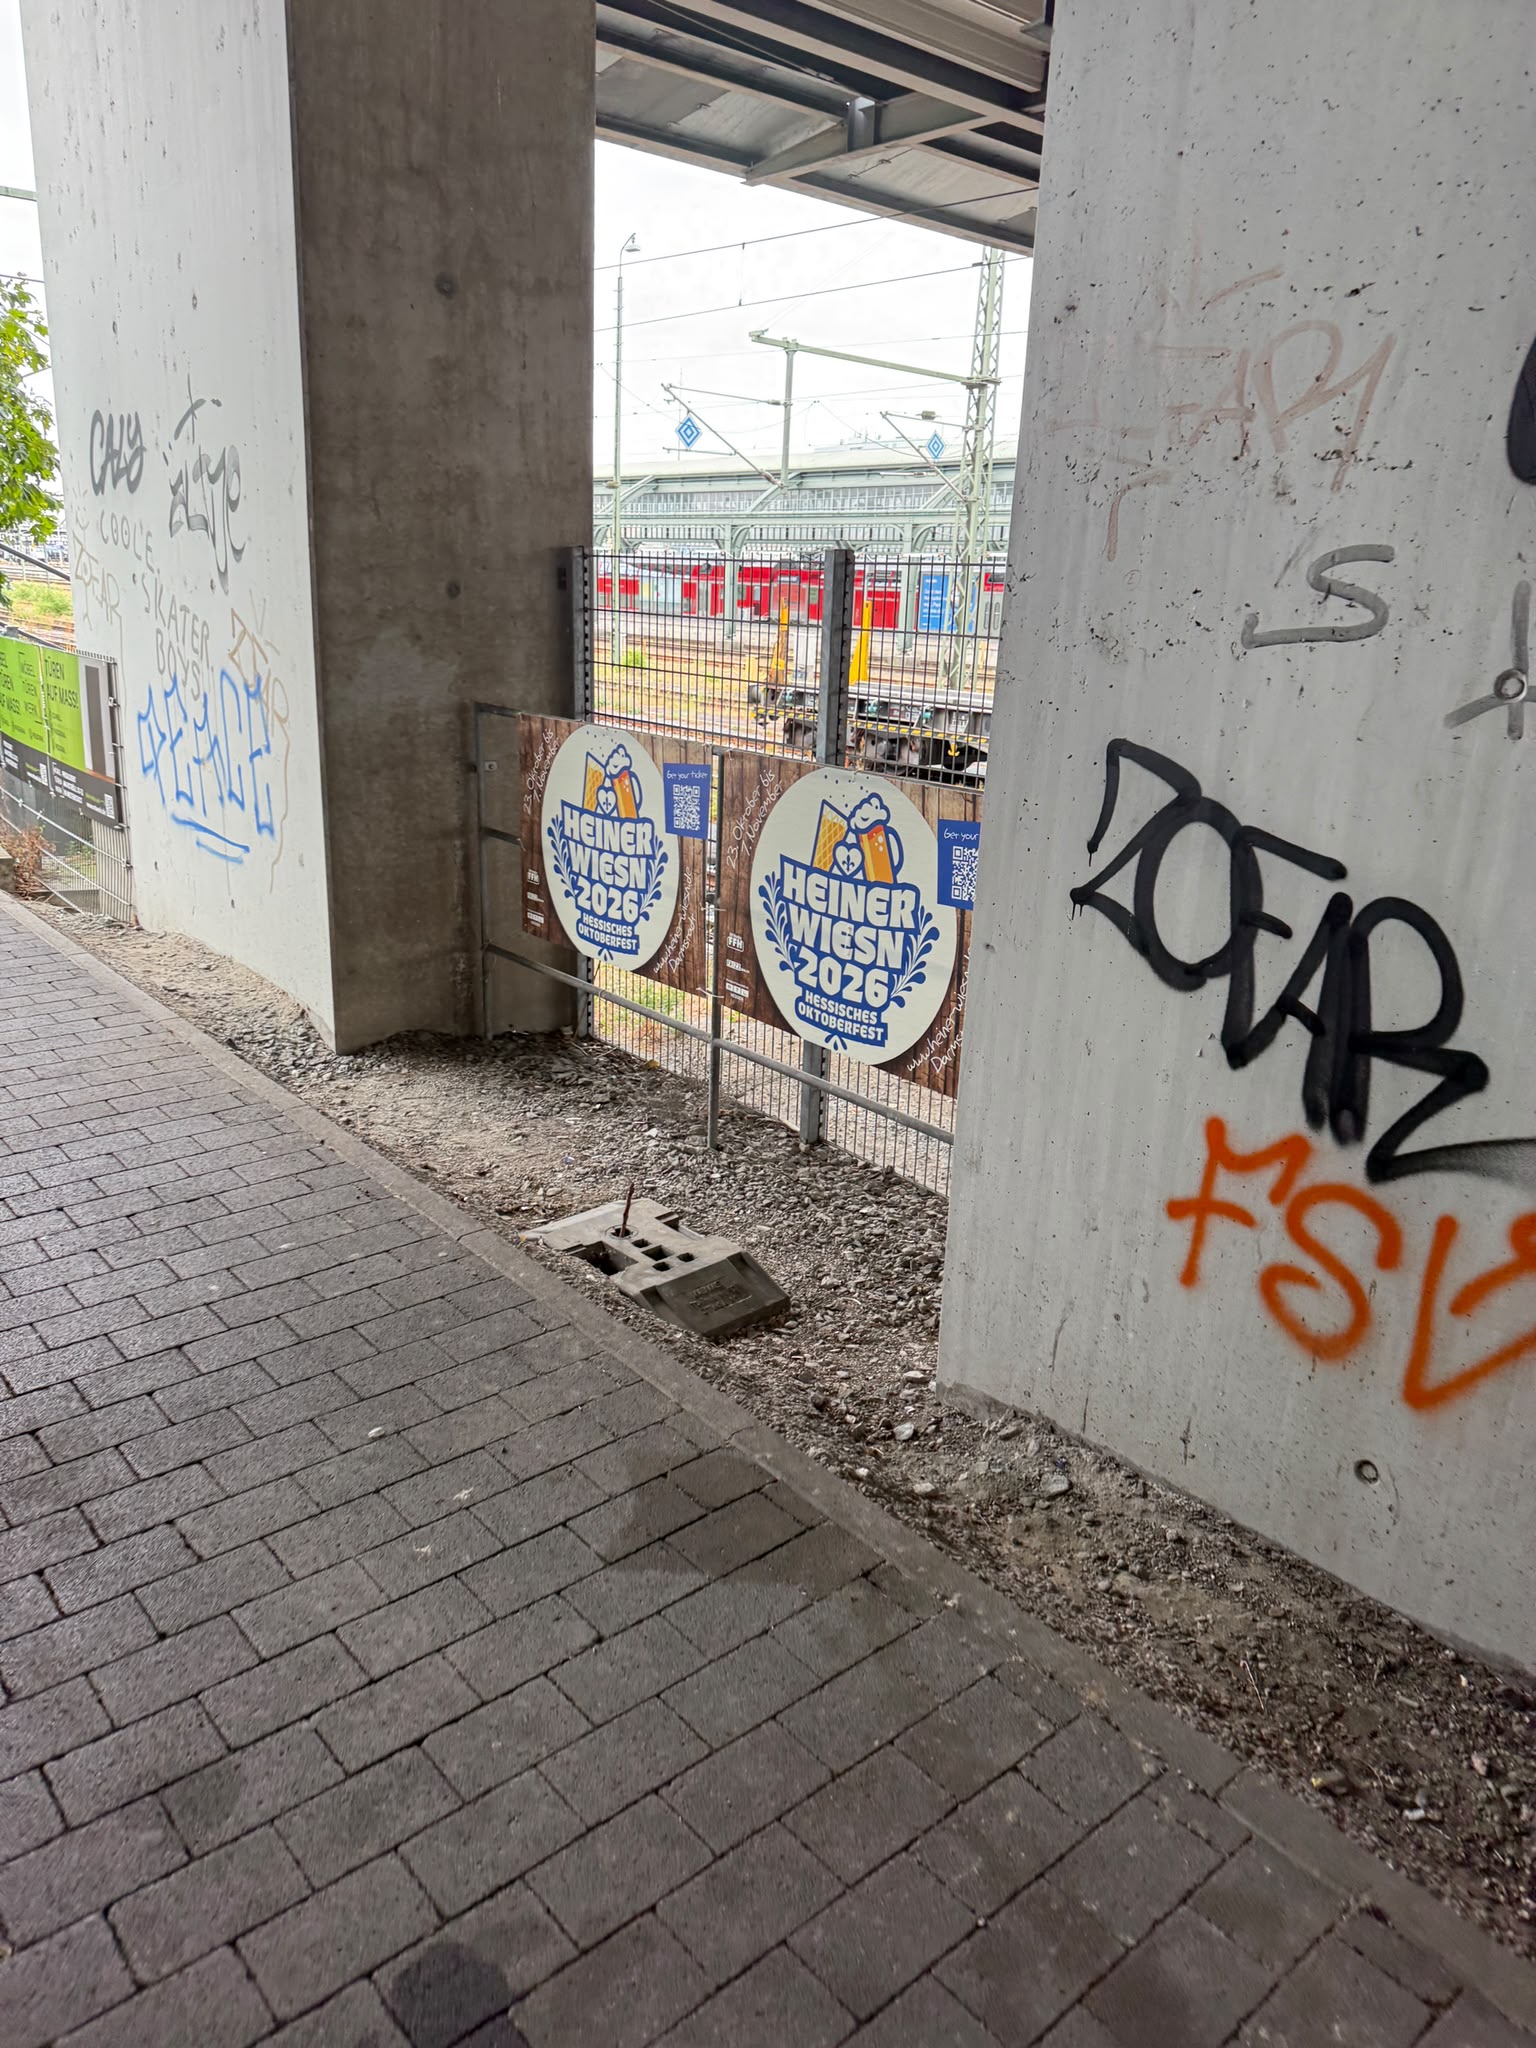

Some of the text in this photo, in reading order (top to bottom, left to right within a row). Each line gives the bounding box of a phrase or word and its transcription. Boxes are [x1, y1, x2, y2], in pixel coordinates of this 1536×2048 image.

[142, 573, 210, 672] SKATER
[760, 769, 775, 787] bis
[563, 805, 653, 856] HEINER
[746, 780, 783, 842] November
[568, 840, 646, 889] WIESN
[577, 876, 638, 923] 2026
[783, 861, 916, 929] HEINER
[578, 923, 638, 950] OKTOBERFEST
[583, 913, 633, 937] HESSISCHES
[788, 902, 905, 970] WIESN
[798, 946, 889, 1008] 2026
[798, 1002, 884, 1041] OKTOBERFEST
[805, 990, 878, 1026] HESSISCHES
